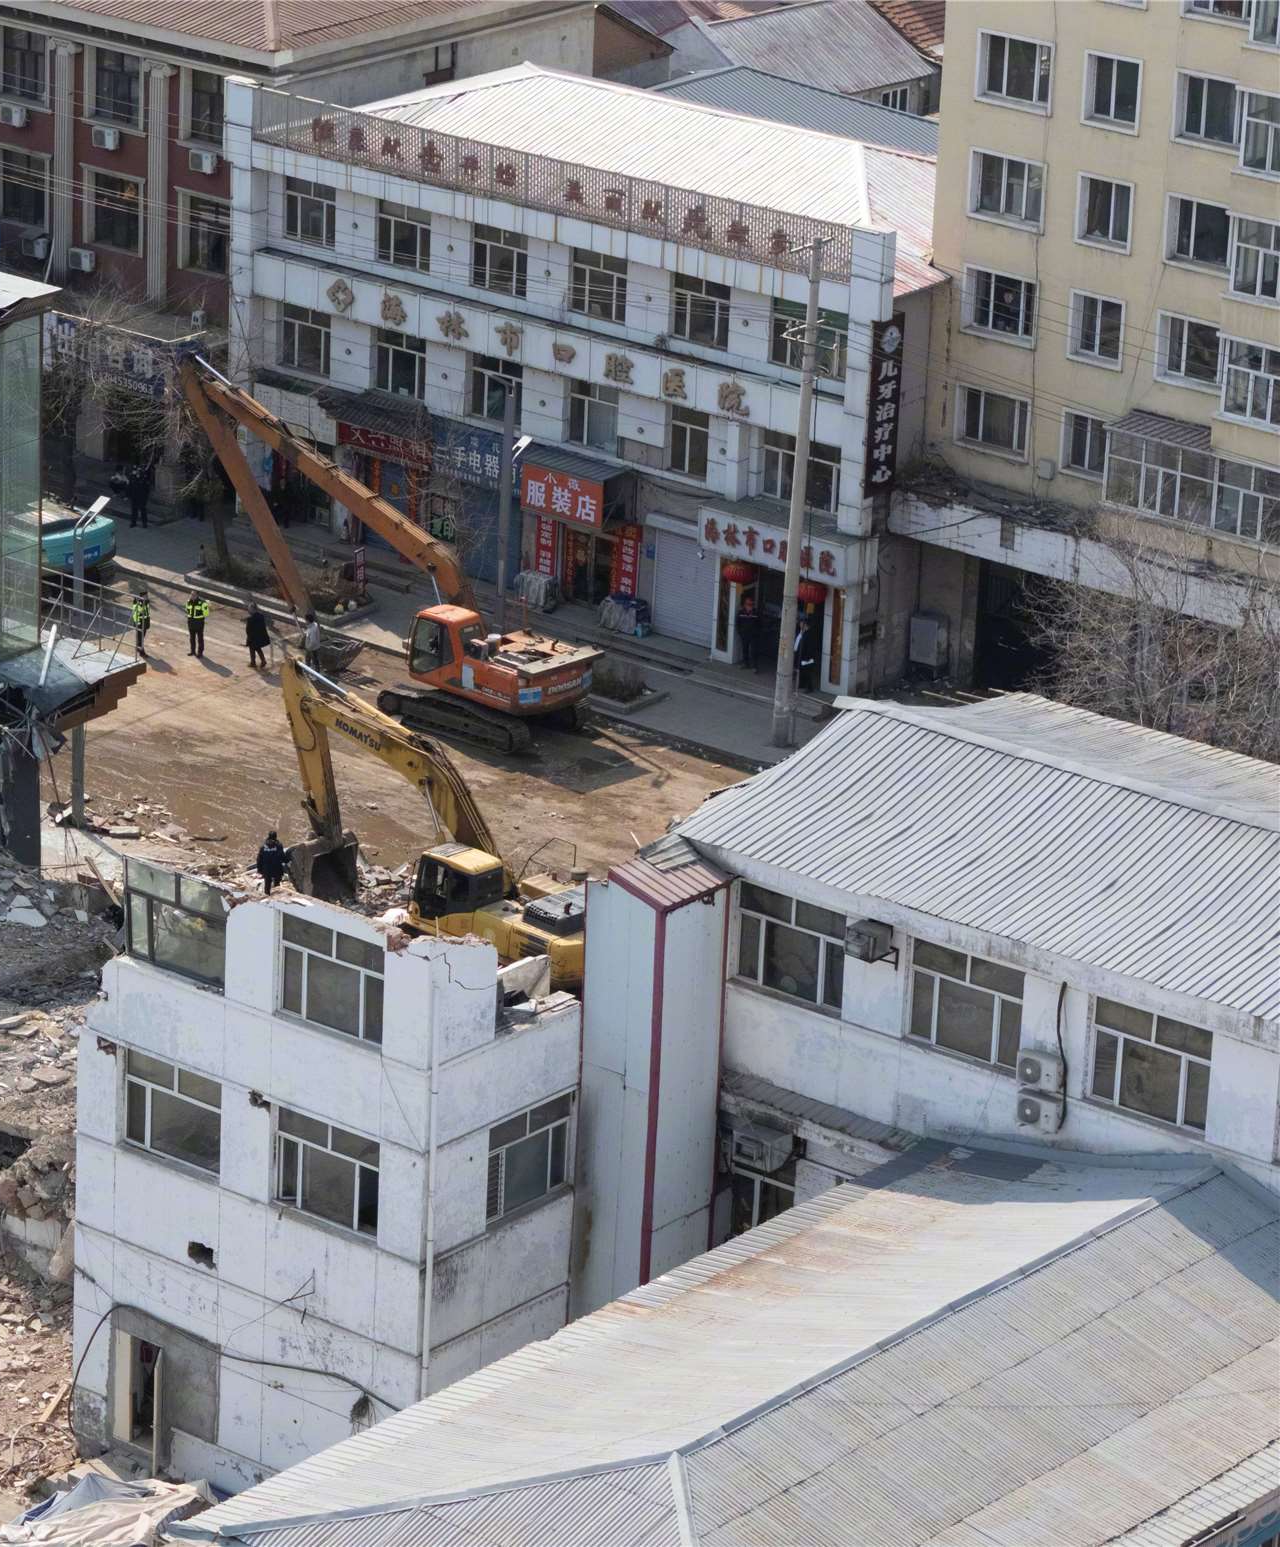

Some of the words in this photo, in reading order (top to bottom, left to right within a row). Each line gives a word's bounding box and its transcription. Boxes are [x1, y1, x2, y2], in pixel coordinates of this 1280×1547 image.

[381, 293, 750, 417] 海林市口腔医院
[872, 360, 898, 483] 儿牙治疗中心
[335, 718, 381, 752] KOMATSU
